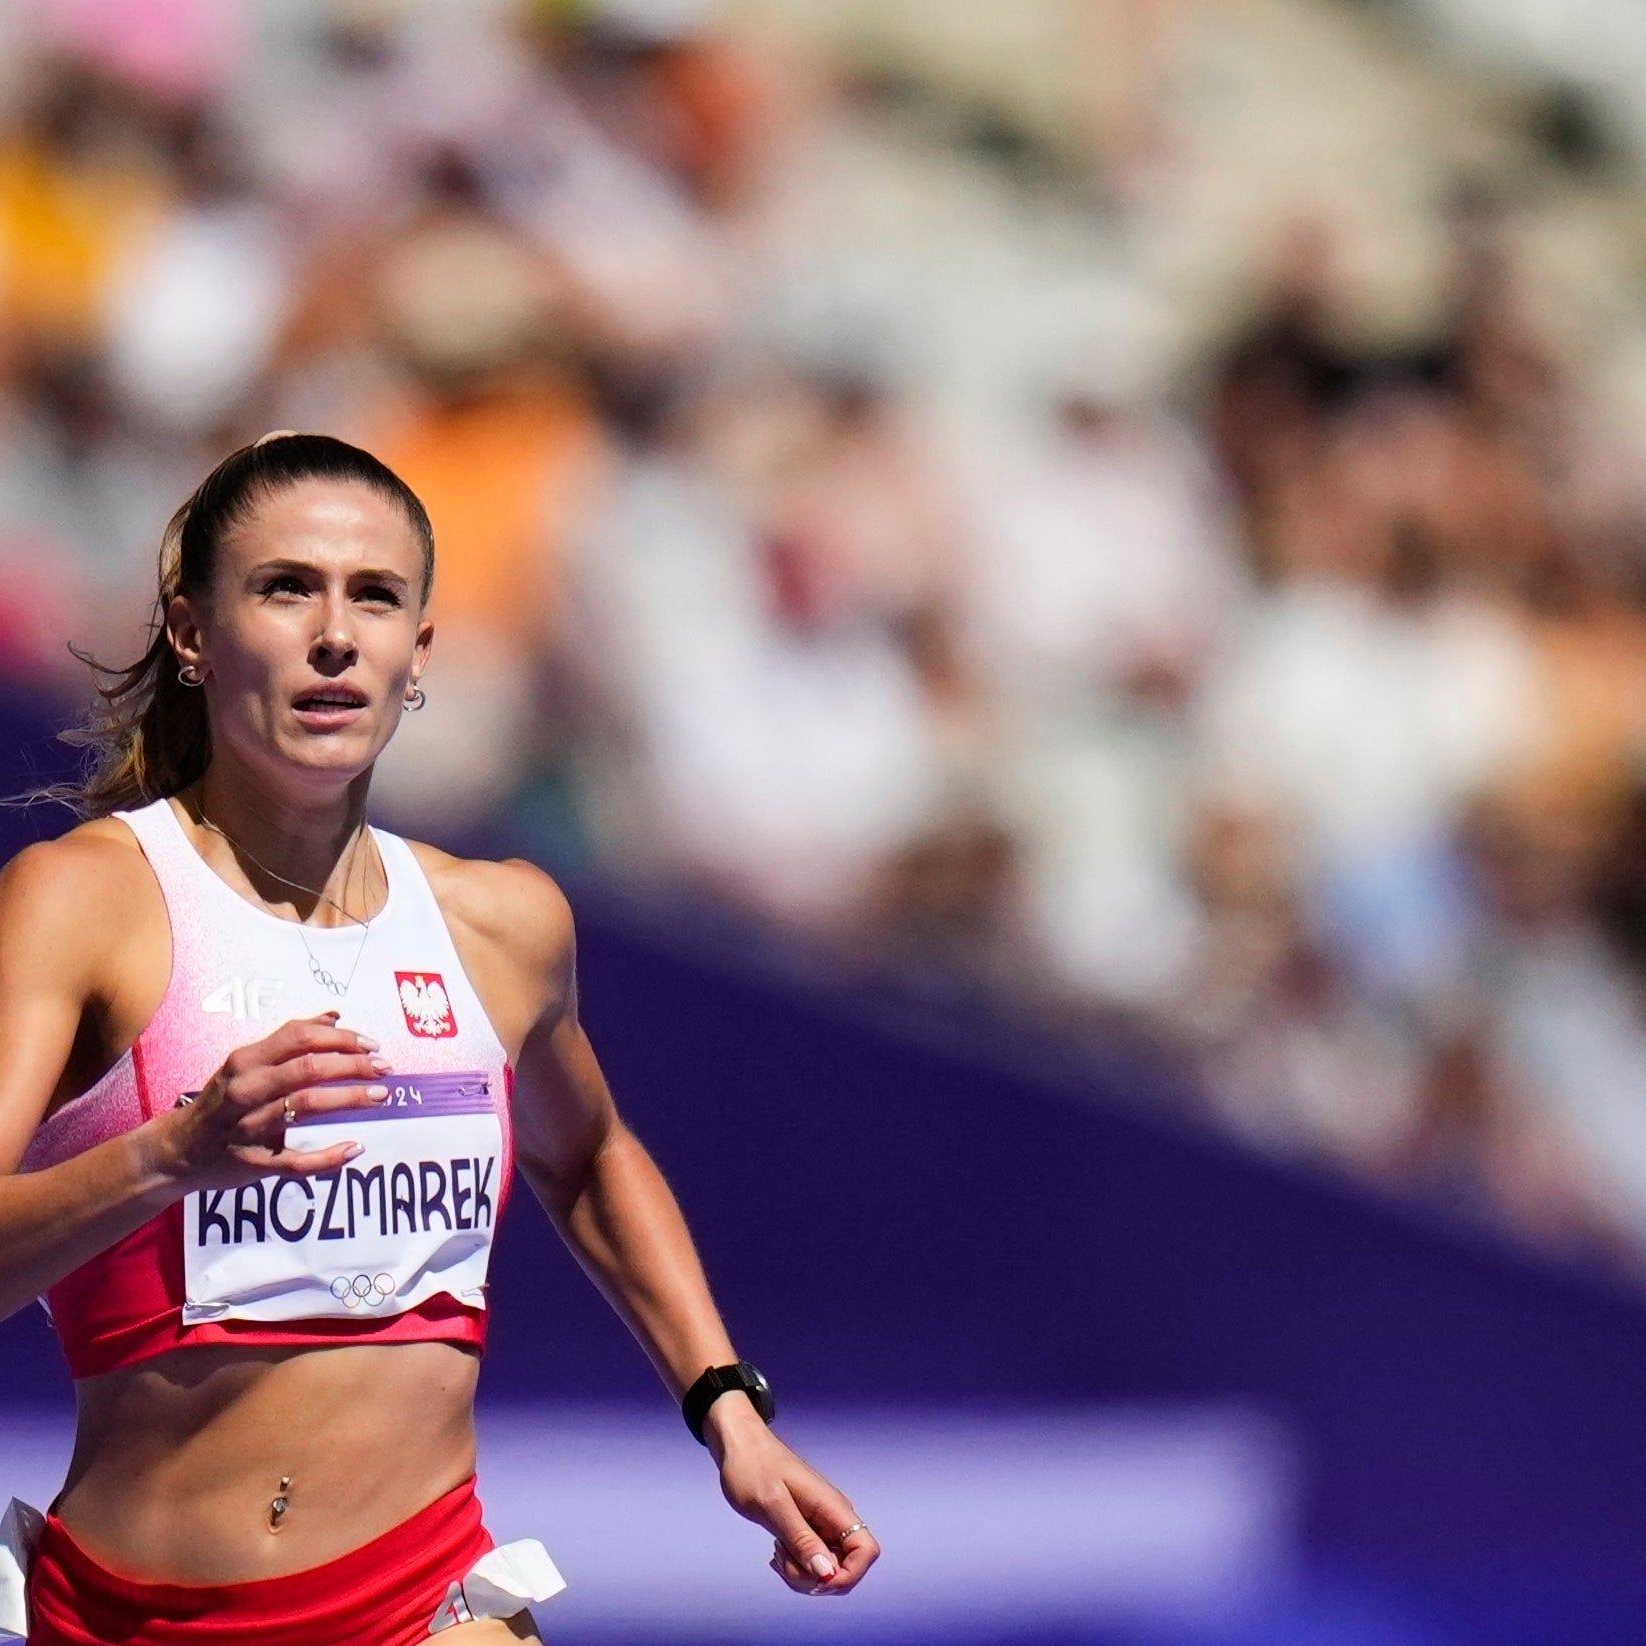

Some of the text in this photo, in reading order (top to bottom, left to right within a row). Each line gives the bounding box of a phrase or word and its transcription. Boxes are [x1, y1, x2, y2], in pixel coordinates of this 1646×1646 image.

[382, 1085, 423, 1107] 24
[198, 1156, 495, 1247] KACZMAREK
[428, 1580, 474, 1635] 4
